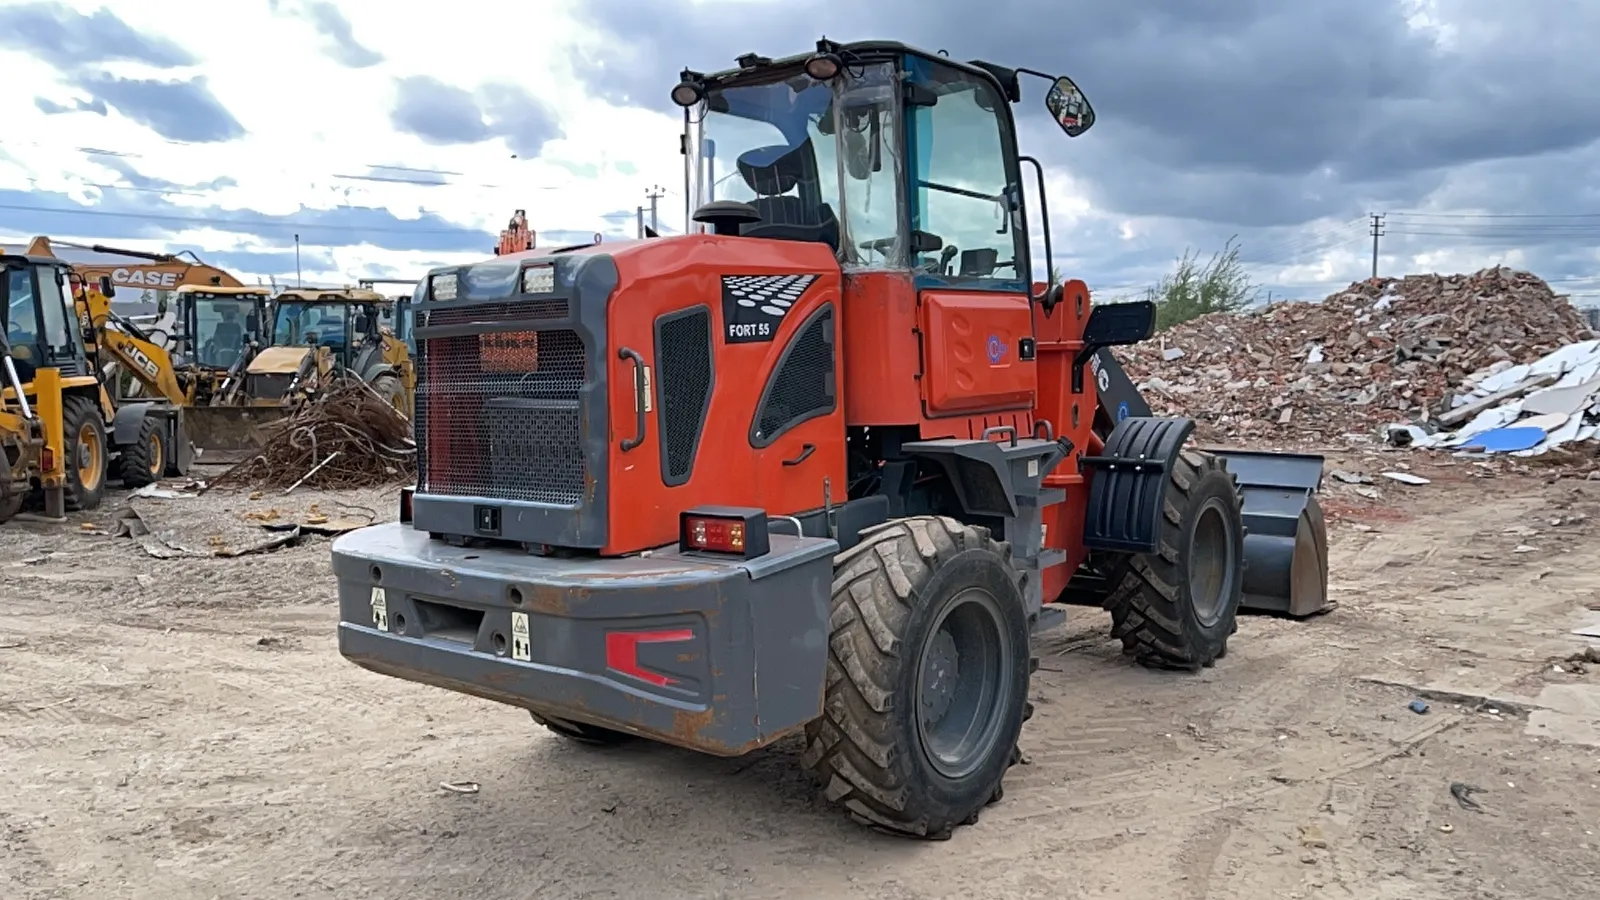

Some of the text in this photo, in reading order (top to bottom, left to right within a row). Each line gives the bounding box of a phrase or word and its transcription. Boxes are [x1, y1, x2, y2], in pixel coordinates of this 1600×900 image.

[112, 268, 177, 286] CASE
[729, 323, 770, 337] FORT 55
[124, 344, 159, 377] JCB
